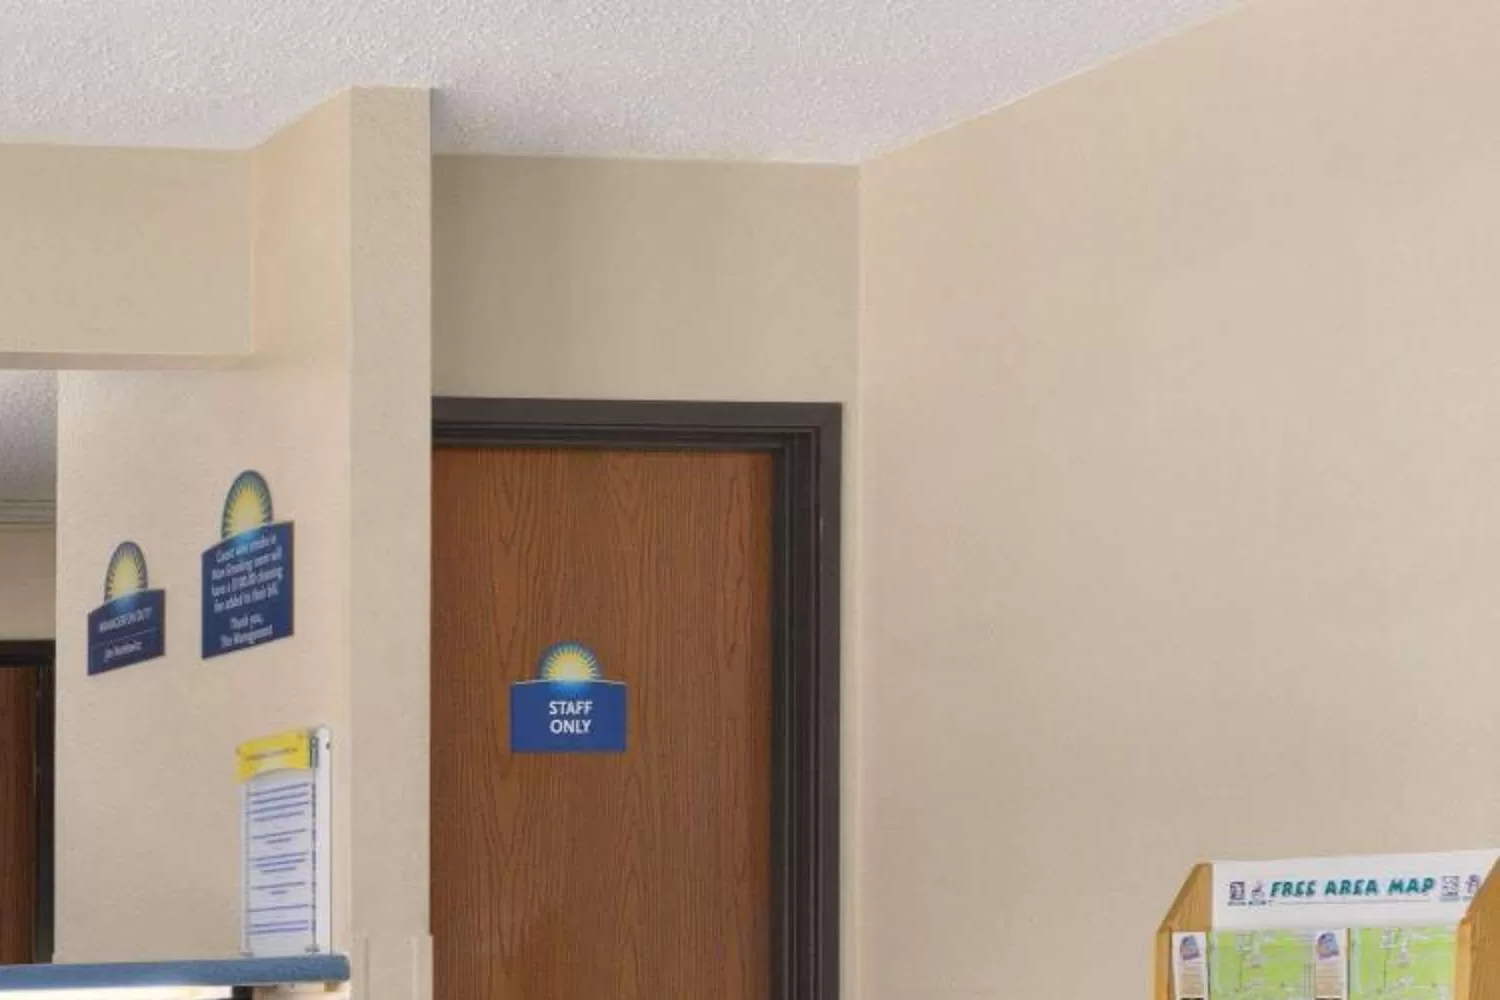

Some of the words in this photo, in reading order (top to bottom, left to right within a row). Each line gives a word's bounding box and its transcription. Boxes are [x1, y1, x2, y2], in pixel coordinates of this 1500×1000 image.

[549, 700, 593, 715] STAFF
[549, 719, 592, 734] ONLY
[1269, 879, 1318, 898] FREE
[1324, 877, 1379, 897] AREA
[1388, 876, 1436, 894] MAP
